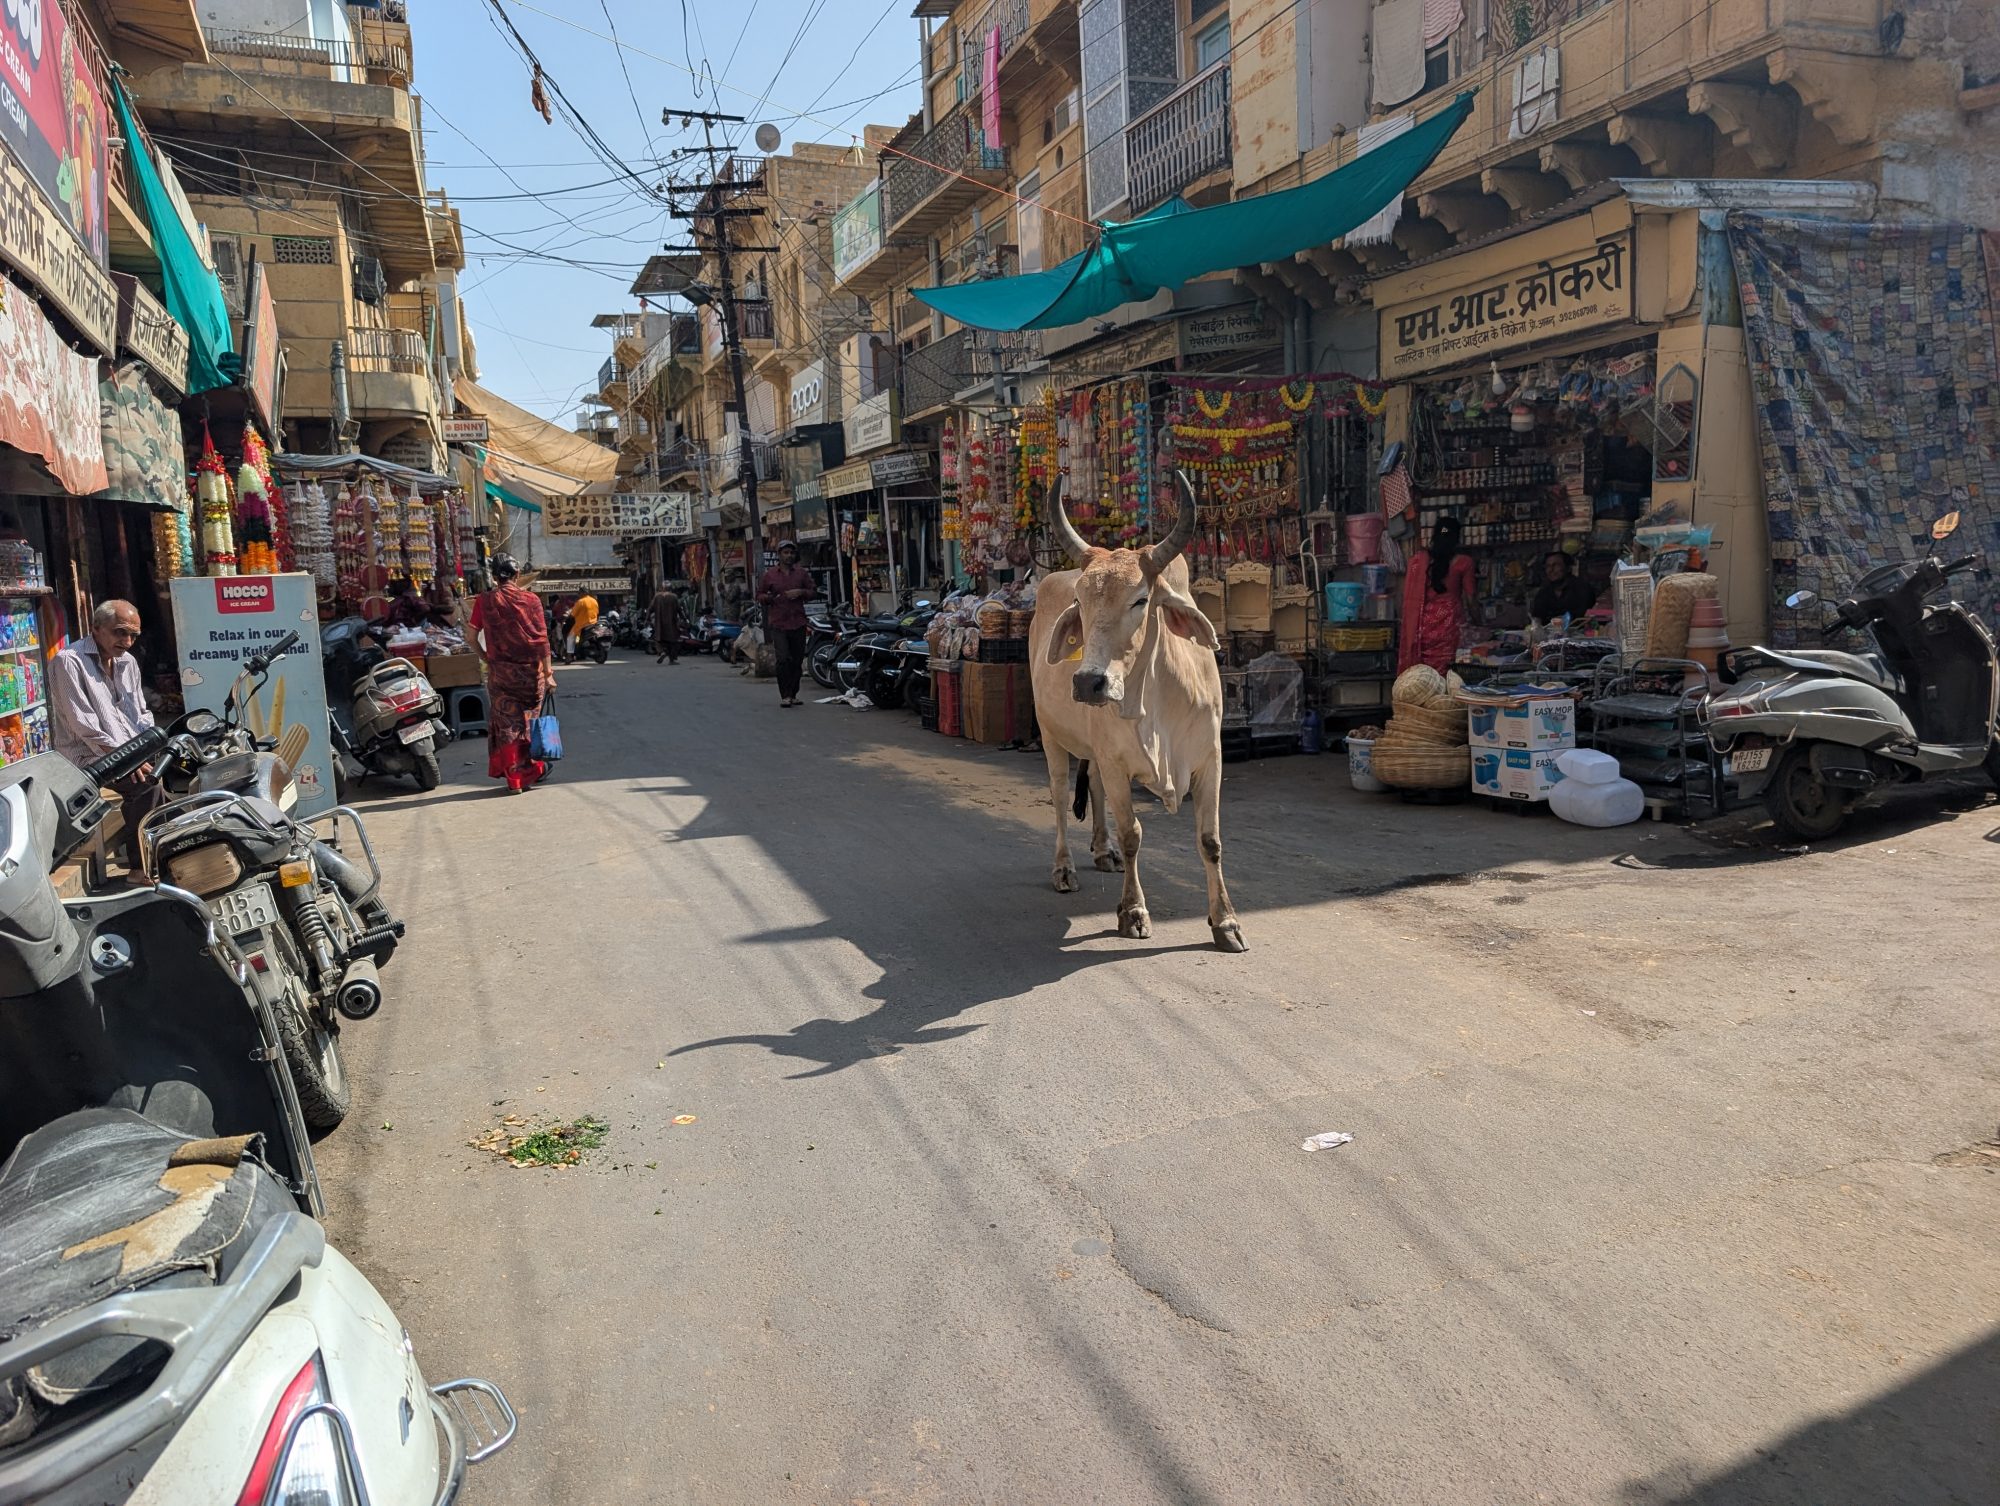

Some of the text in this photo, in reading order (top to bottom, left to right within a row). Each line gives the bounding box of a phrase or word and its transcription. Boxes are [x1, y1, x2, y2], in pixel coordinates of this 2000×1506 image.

[0, 154, 46, 271] ईसक्रीम
[1491, 326, 1498, 340] के
[454, 422, 484, 431] BINNY
[622, 528, 667, 536] HANDICRAFT
[222, 585, 268, 599] HOCCO
[209, 628, 286, 641] Relax in our
[189, 648, 239, 661] dreamy
[1535, 707, 1553, 716] EASY
[1554, 705, 1572, 714] MOP
[104, 737, 149, 769] HONDA
[1536, 758, 1553, 767] EASY
[211, 892, 249, 917] J15
